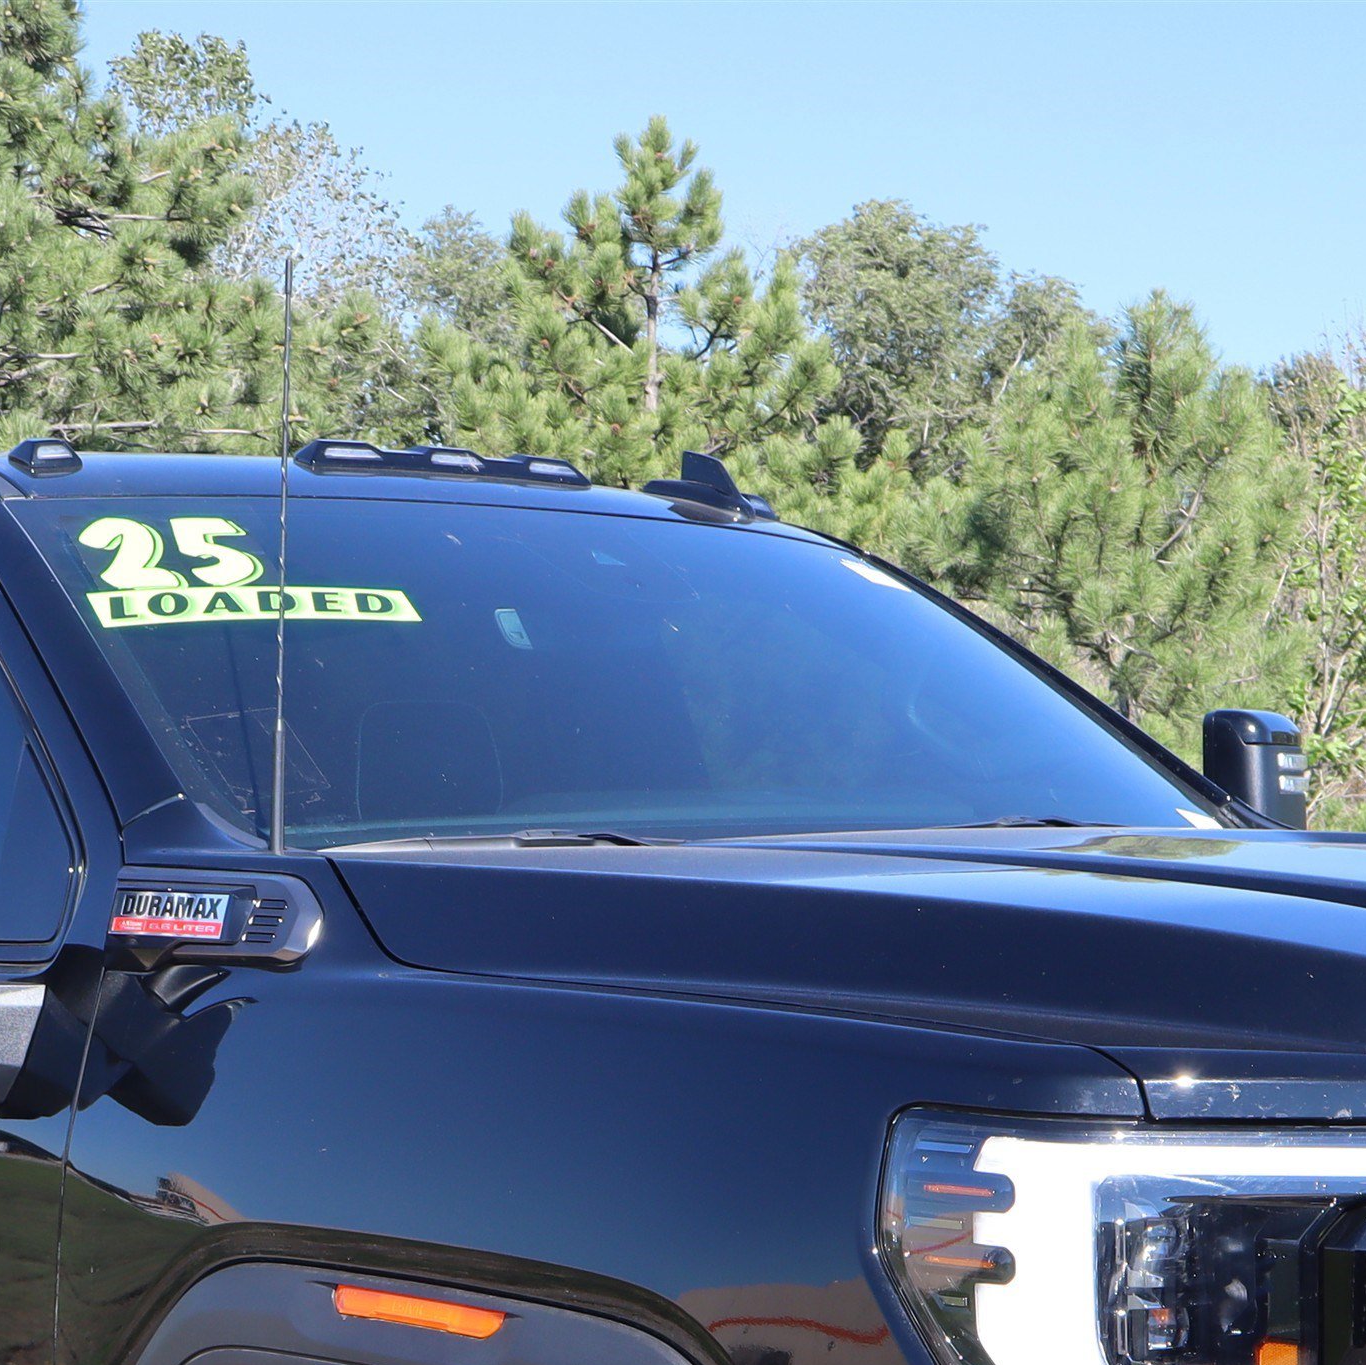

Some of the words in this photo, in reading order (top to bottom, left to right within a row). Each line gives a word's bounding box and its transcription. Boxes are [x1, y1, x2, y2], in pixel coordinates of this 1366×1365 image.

[78, 517, 264, 589] 25
[108, 592, 395, 619] LOADED
[122, 895, 223, 919] DURAMAX
[174, 924, 216, 934] LITER
